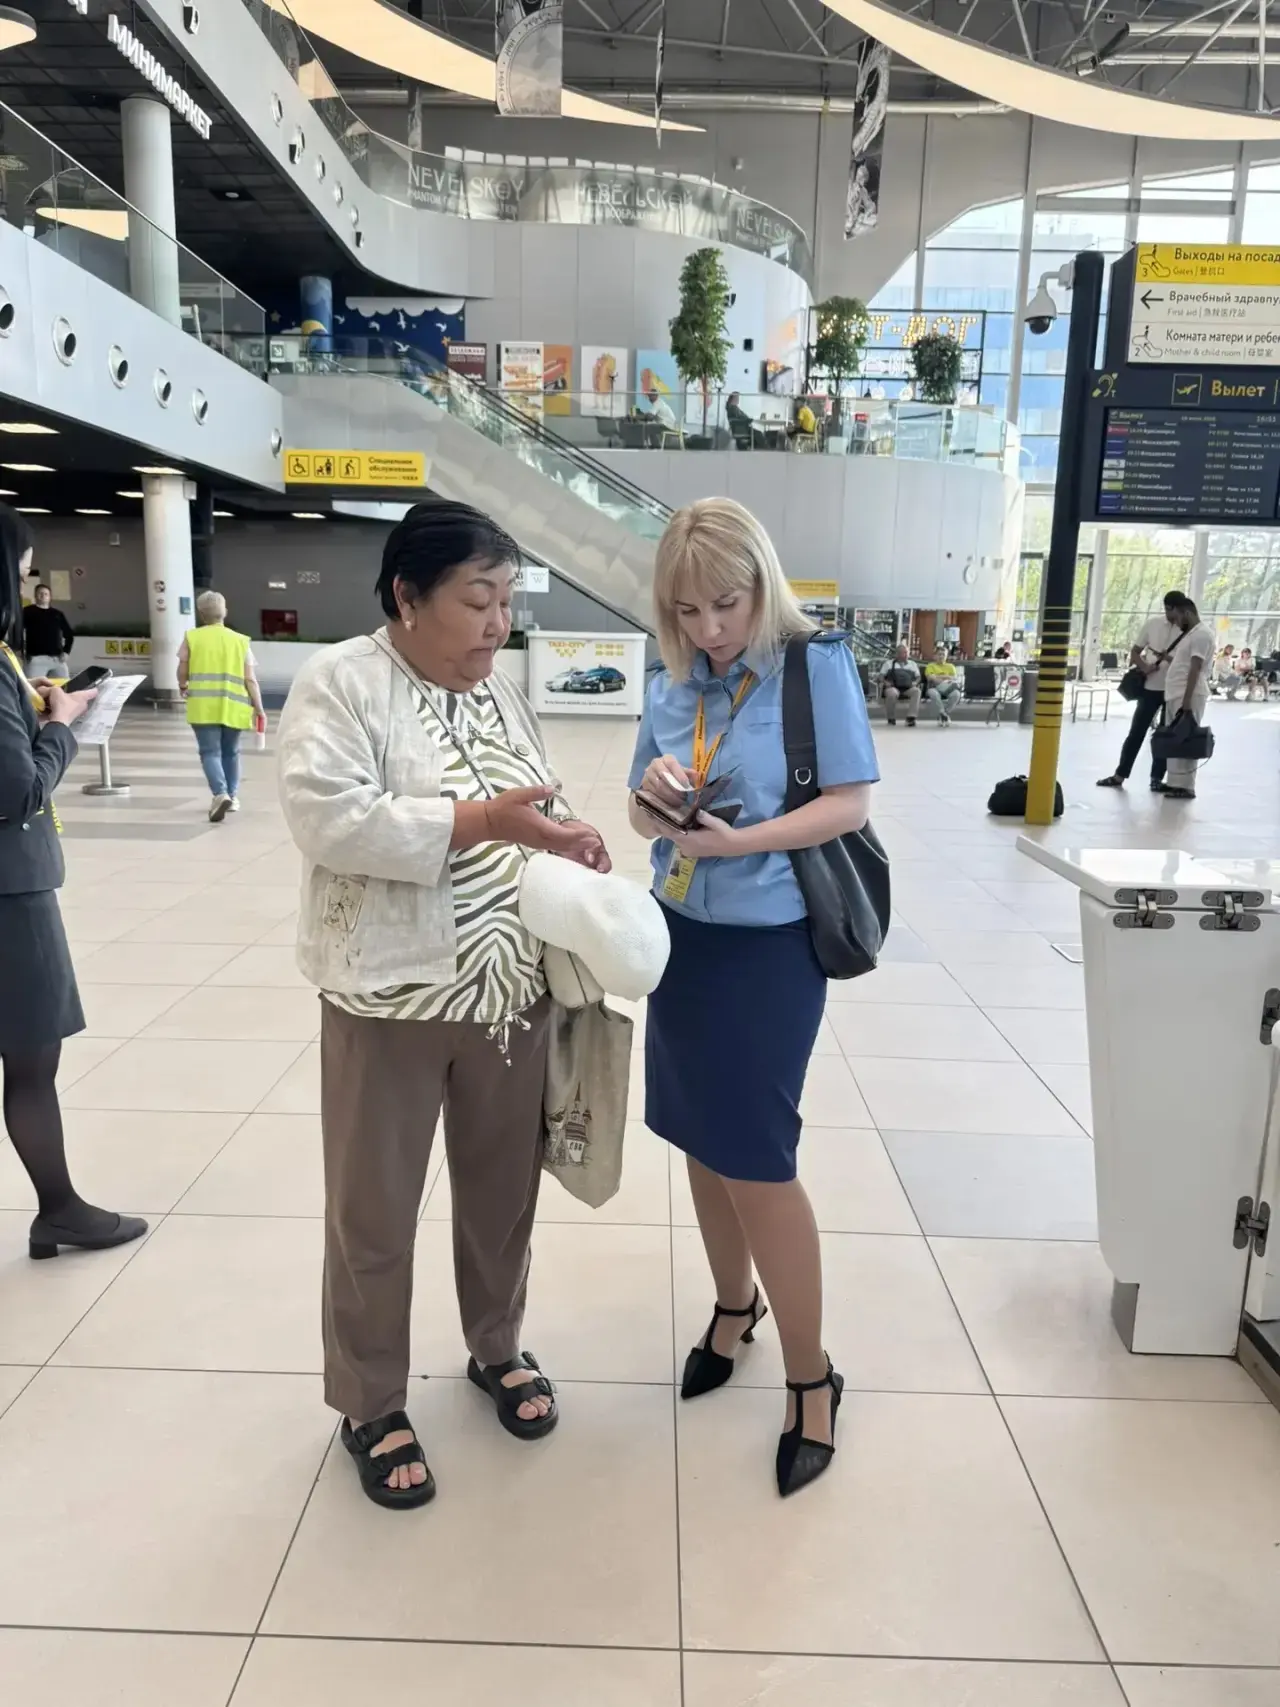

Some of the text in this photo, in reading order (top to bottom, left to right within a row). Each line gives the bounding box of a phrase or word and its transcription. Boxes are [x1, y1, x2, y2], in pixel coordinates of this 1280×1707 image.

[107, 13, 213, 140] МИНИМАРКЕТ
[1174, 247, 1225, 263] Выходы
[1228, 252, 1242, 263] на
[1172, 267, 1194, 277] Gates
[1169, 290, 1280, 307] Врачебный здравпу
[1167, 308, 1198, 317] First aid
[1165, 329, 1207, 342] Комната
[1209, 333, 1244, 346] матери
[1246, 335, 1253, 343] и
[1164, 348, 1192, 357] Mother
[1201, 348, 1221, 358] child
[1222, 350, 1241, 358] room
[1211, 379, 1266, 397] Вылет
